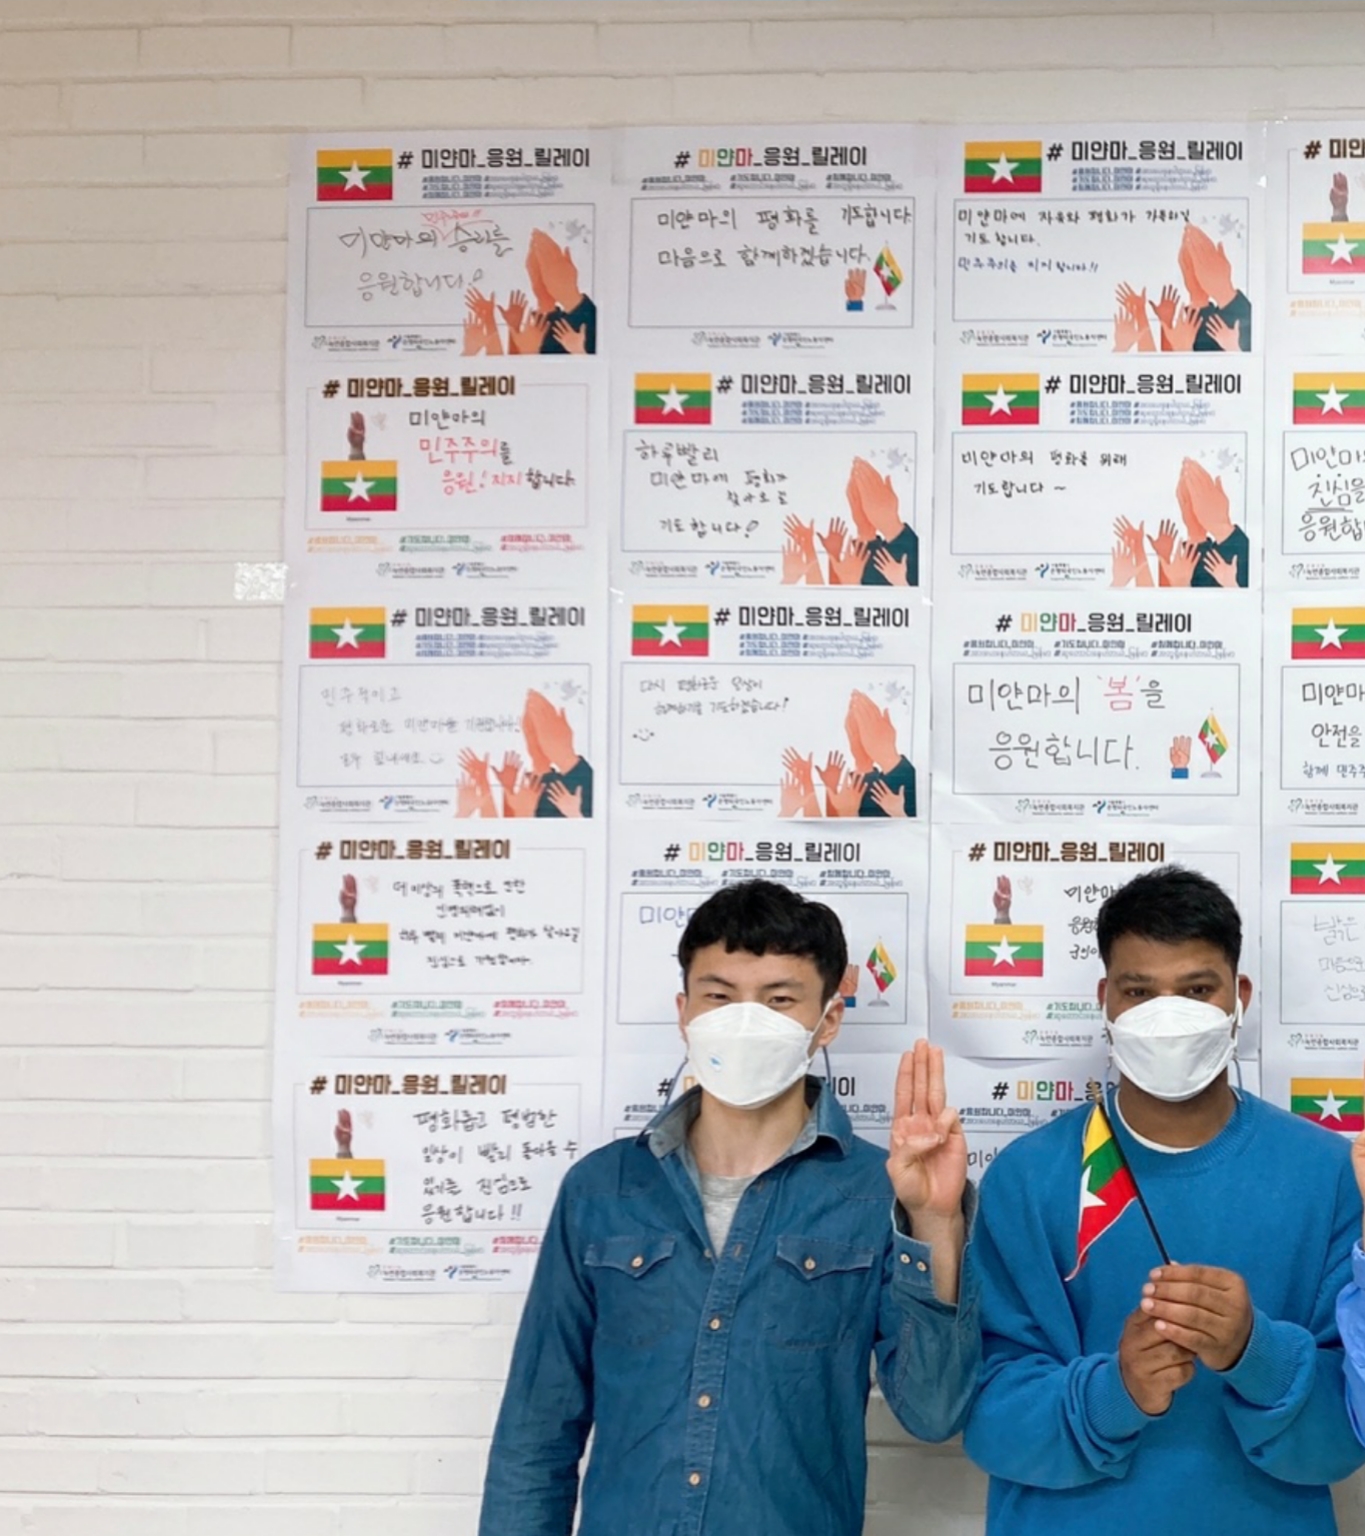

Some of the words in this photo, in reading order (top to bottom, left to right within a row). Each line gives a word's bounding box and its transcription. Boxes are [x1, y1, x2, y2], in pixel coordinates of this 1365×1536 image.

[397, 152, 414, 169] #
[422, 148, 589, 169] 미얀마_응원_릴레이
[674, 151, 690, 168] #
[699, 146, 866, 167] 미얀마_응원_릴레이
[1304, 141, 1322, 159] #
[657, 208, 736, 230] 미얀마의
[756, 206, 818, 235] 평화를
[658, 247, 726, 268] 마음으로
[409, 409, 485, 430] 미얀마의
[996, 615, 1012, 632] #
[1022, 613, 1191, 632] 미얀마_응원_릴레이
[968, 676, 1079, 715] 미얀마의
[988, 731, 1139, 770] 응원합니다.
